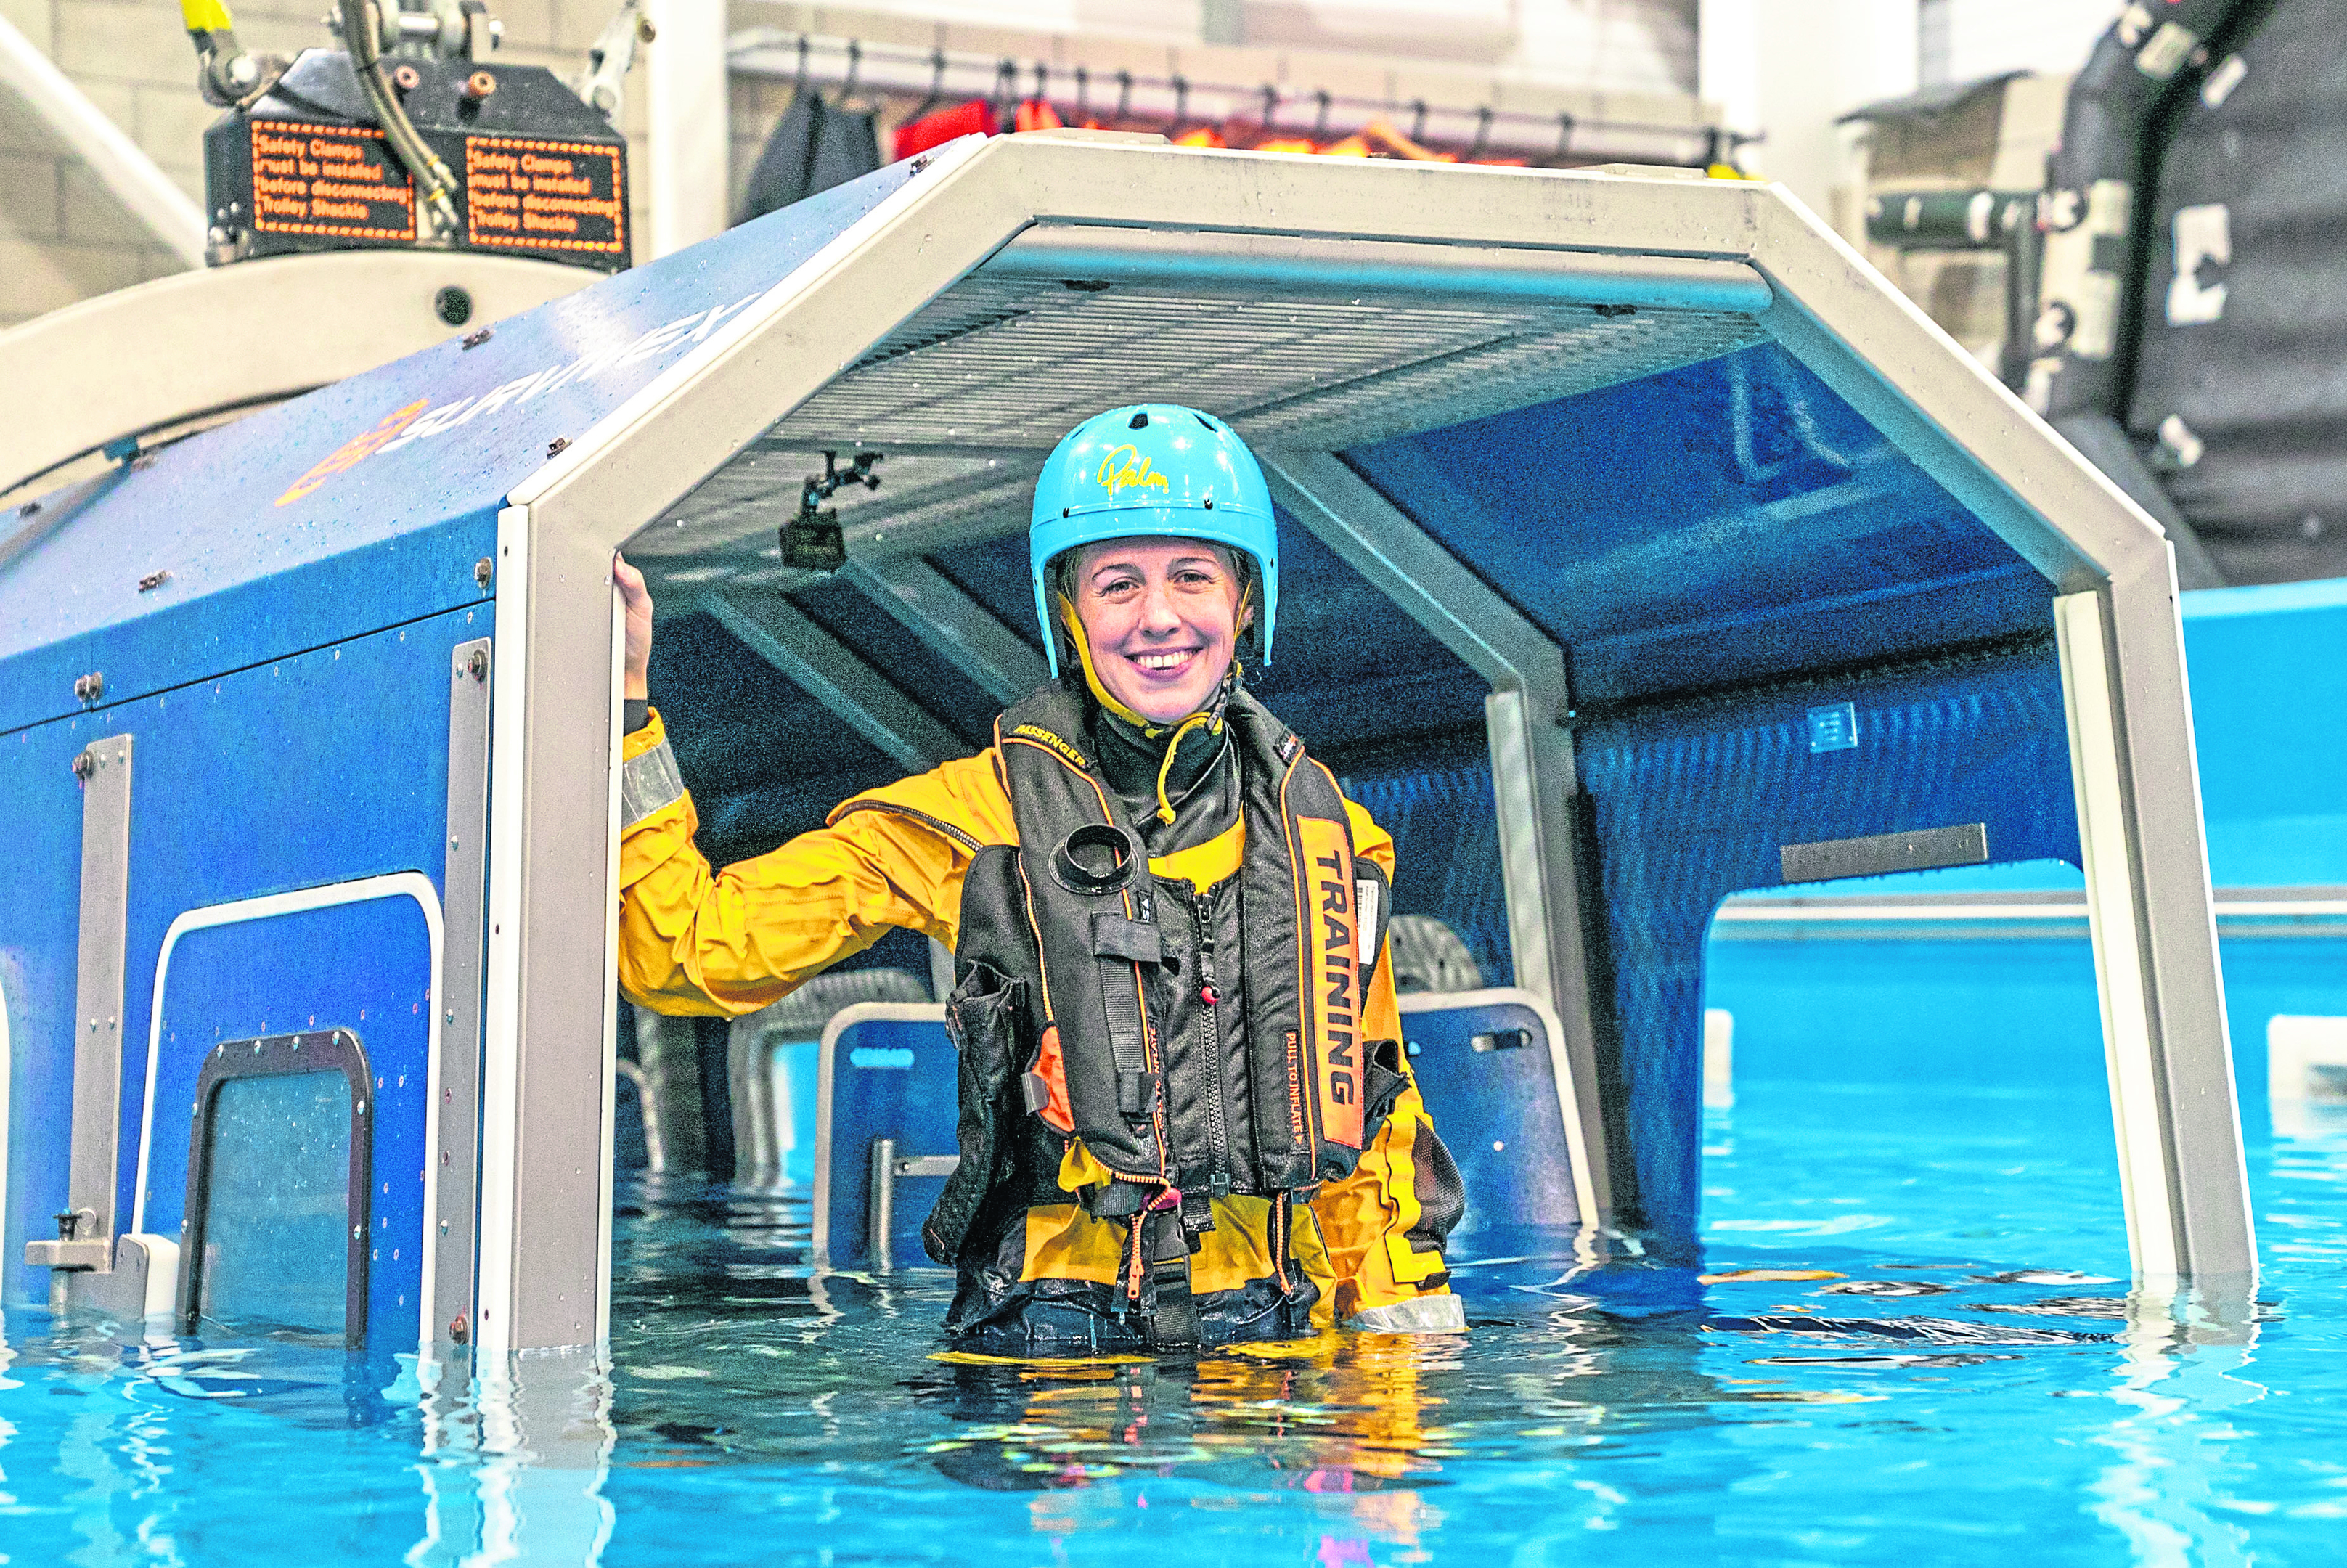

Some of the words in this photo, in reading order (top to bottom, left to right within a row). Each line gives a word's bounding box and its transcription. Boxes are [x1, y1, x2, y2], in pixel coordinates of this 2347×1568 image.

[258, 134, 306, 158] Safety
[310, 139, 364, 160] Clamps
[299, 159, 319, 176] be
[322, 159, 383, 181] installed
[473, 150, 518, 173] Safety
[521, 153, 573, 175] Clamps
[259, 176, 307, 195] before
[311, 179, 407, 205] disconnecting
[510, 173, 530, 190] be
[533, 175, 592, 195] installed
[473, 189, 519, 209] before
[1097, 444, 1169, 496] Palm
[1316, 850, 1354, 1106] TRAINING
[1149, 1027, 1160, 1074] NFLATE
[1286, 1032, 1297, 1063] PULL
[1287, 1064, 1298, 1081] TO
[1155, 1079, 1161, 1097] TO
[1289, 1084, 1303, 1133] INFLATE
